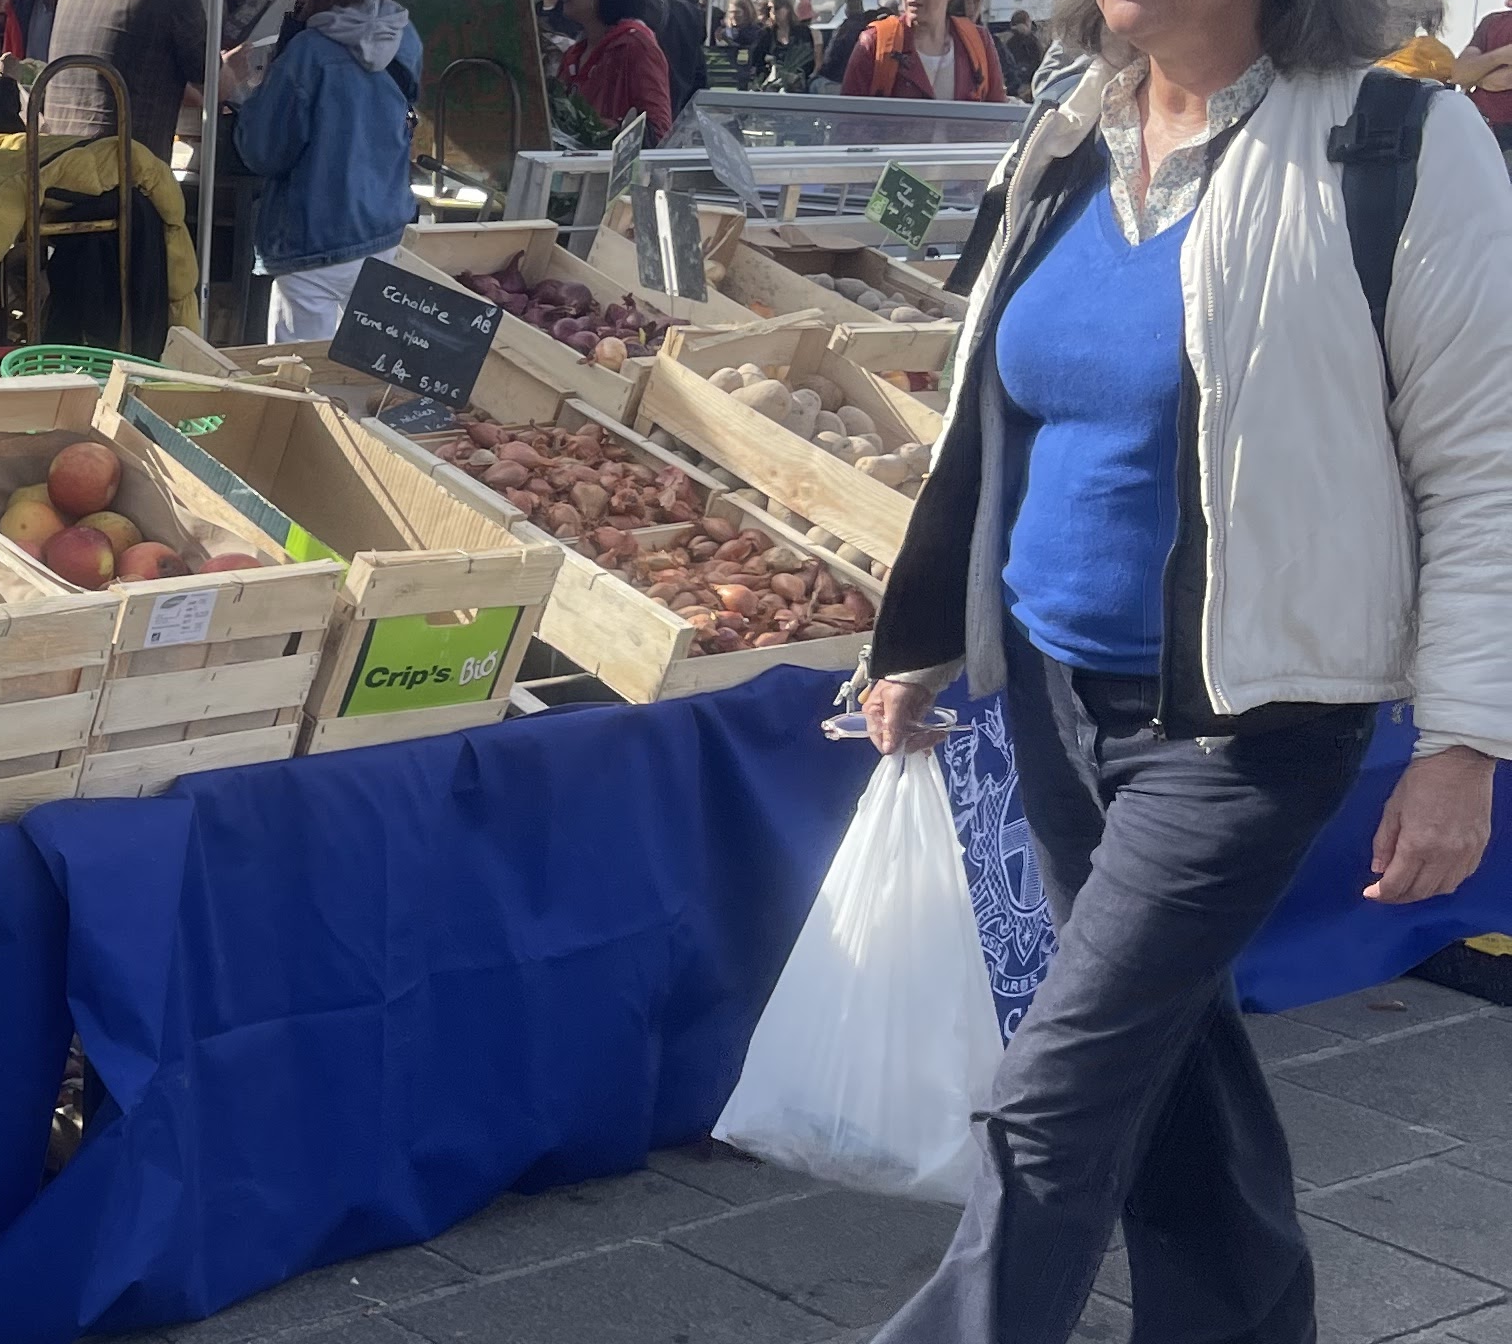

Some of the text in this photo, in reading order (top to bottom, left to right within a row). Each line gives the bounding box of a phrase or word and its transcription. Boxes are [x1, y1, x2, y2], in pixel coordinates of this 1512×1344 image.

[385, 325, 399, 339] de
[470, 314, 492, 335] AB
[419, 375, 449, 395] 5,90
[364, 664, 452, 690] Crip's
